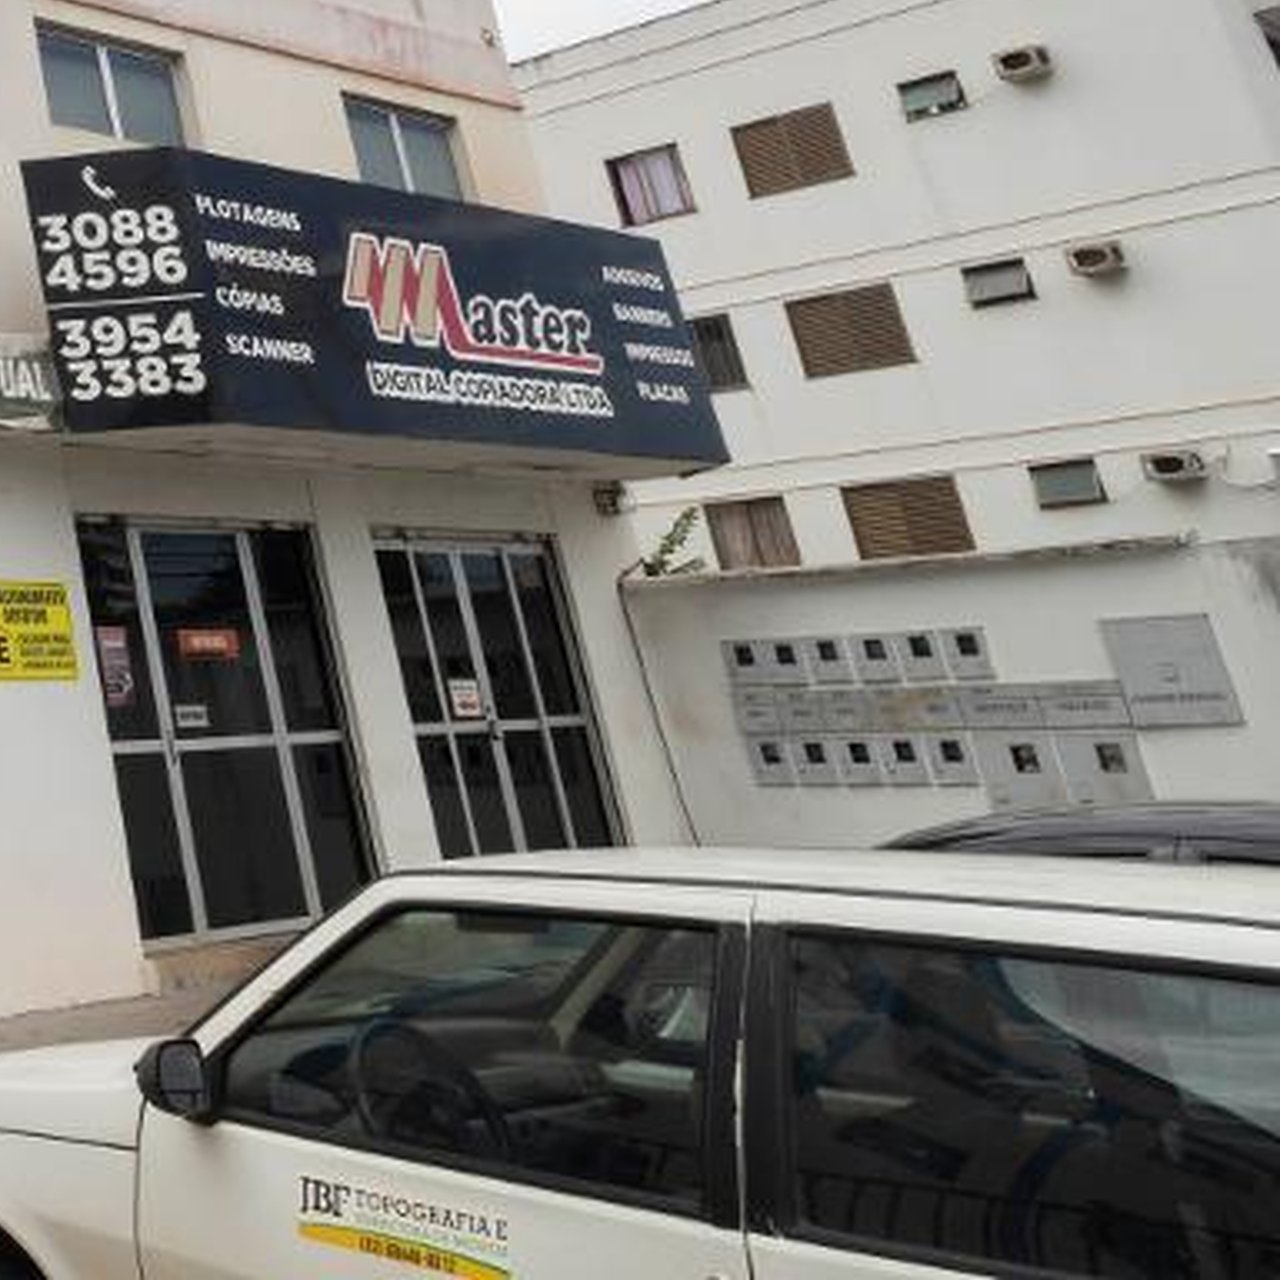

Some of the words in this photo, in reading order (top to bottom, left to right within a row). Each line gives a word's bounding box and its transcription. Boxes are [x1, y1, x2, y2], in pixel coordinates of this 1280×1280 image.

[39, 205, 180, 252] 3088
[195, 194, 302, 231] PLOTAGENS
[45, 245, 188, 291] 4596
[215, 283, 284, 315] CÓPIAS
[344, 233, 603, 375] Master
[56, 310, 202, 359] 3954
[226, 333, 315, 364] SCANNER
[66, 354, 207, 401] 3383
[369, 366, 449, 402] DIGITAL
[450, 372, 561, 410] COPIADORA
[300, 1176, 351, 1217] JBF
[354, 1189, 492, 1238] TOPOGRAFIA
